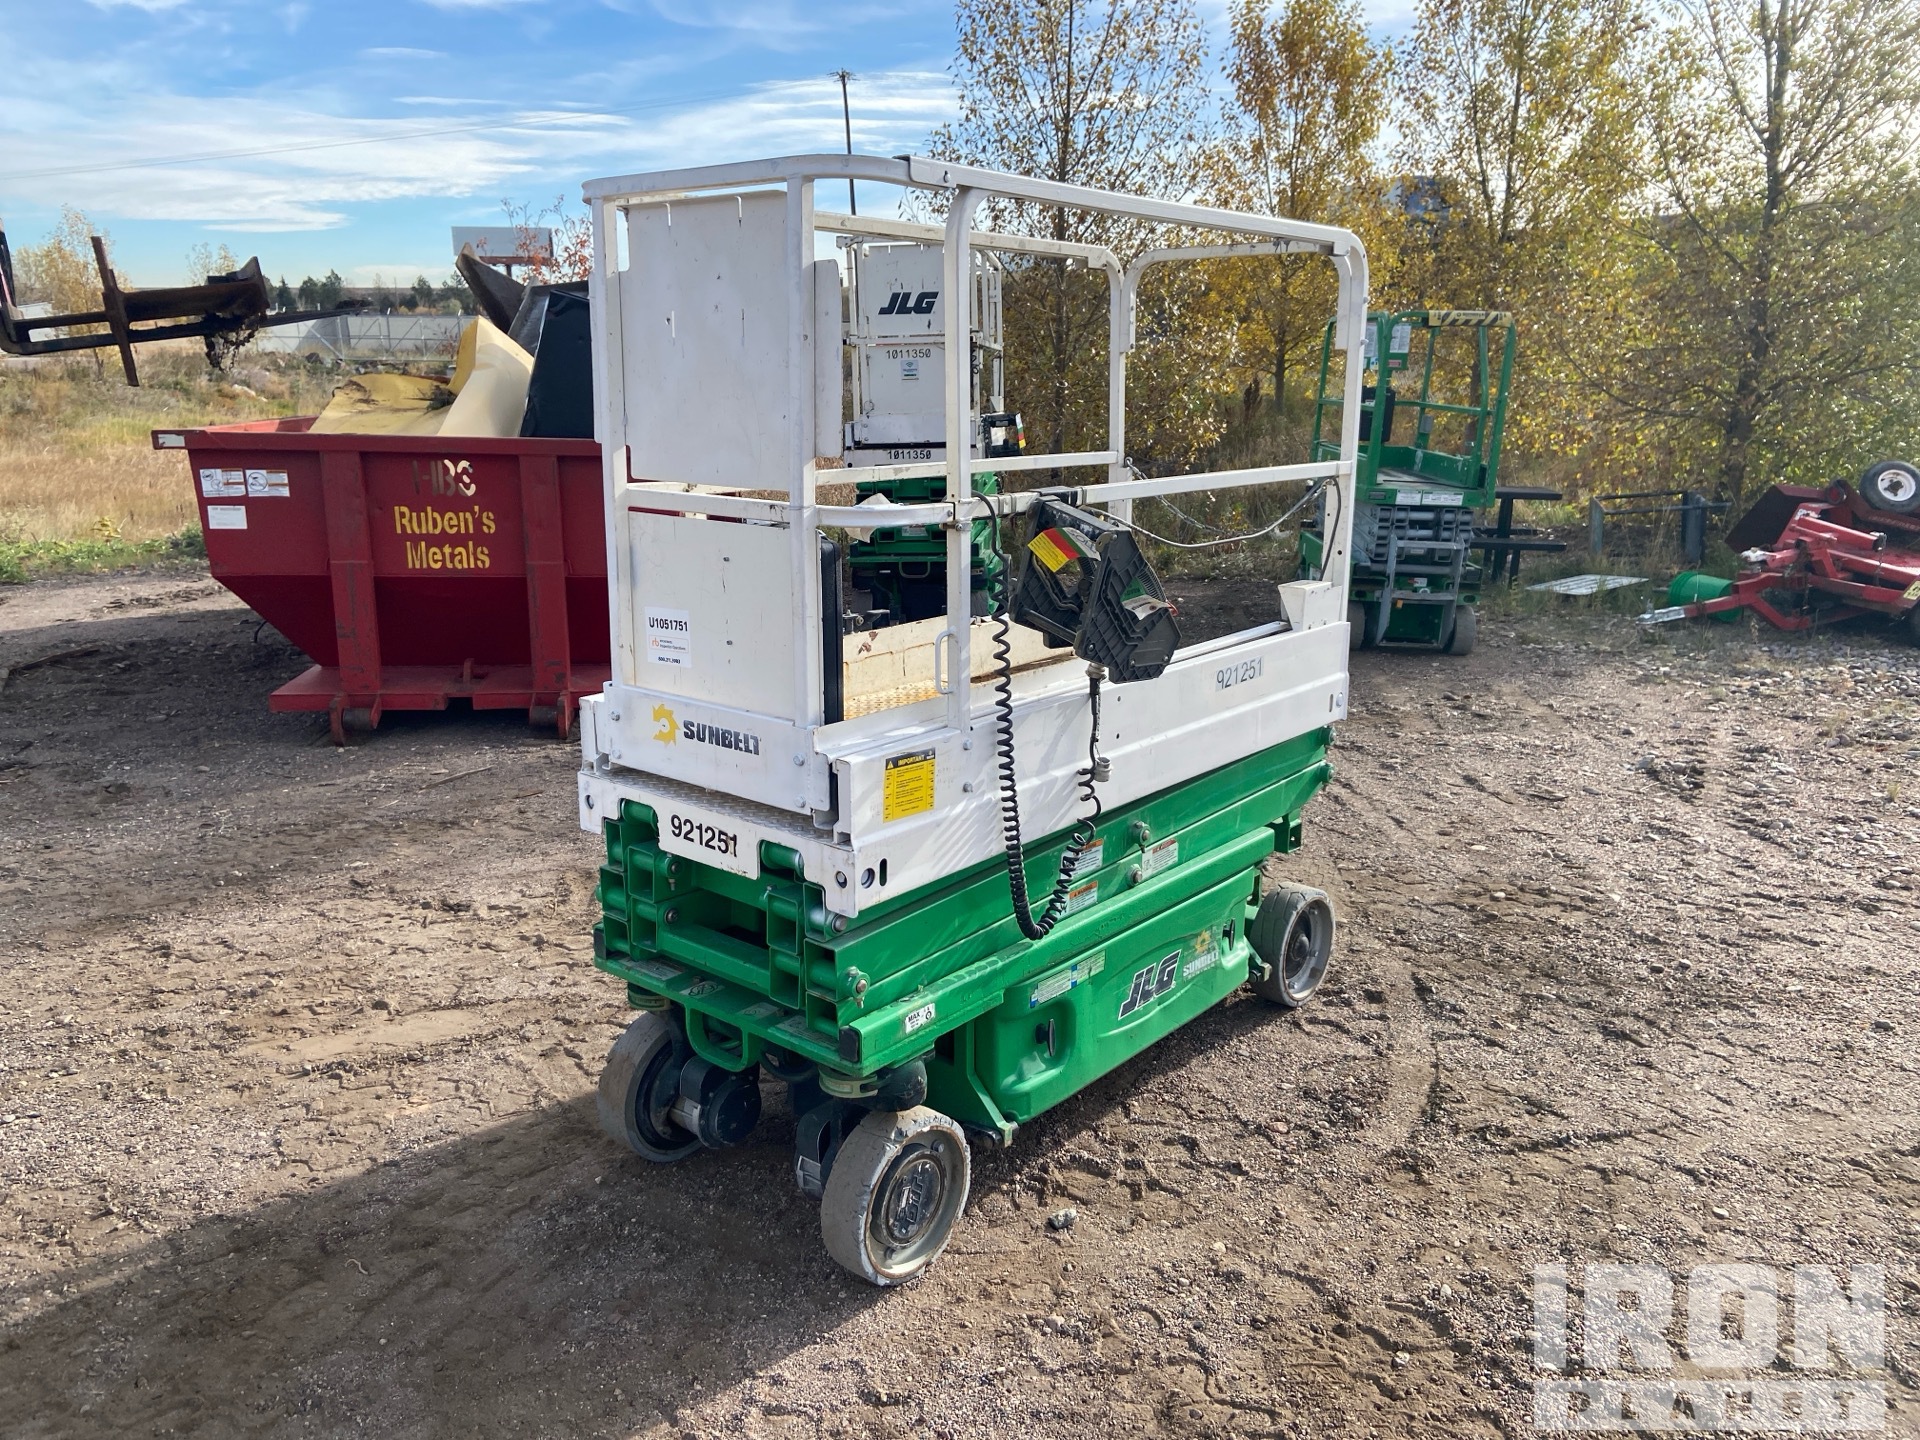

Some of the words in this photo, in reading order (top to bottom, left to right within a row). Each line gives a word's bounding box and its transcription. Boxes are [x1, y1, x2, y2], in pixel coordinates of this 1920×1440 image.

[878, 291, 939, 314] JLG
[886, 348, 931, 359] 1011350
[887, 449, 932, 460] 1011350
[393, 505, 496, 535] Ruben's
[406, 541, 490, 570] Metals
[648, 616, 688, 632] U1051751
[1216, 657, 1262, 690] 921251
[683, 719, 760, 756] SUNBELT
[670, 814, 738, 858] 921251
[1118, 948, 1182, 1021] JLG
[908, 1011, 921, 1023] MAX
